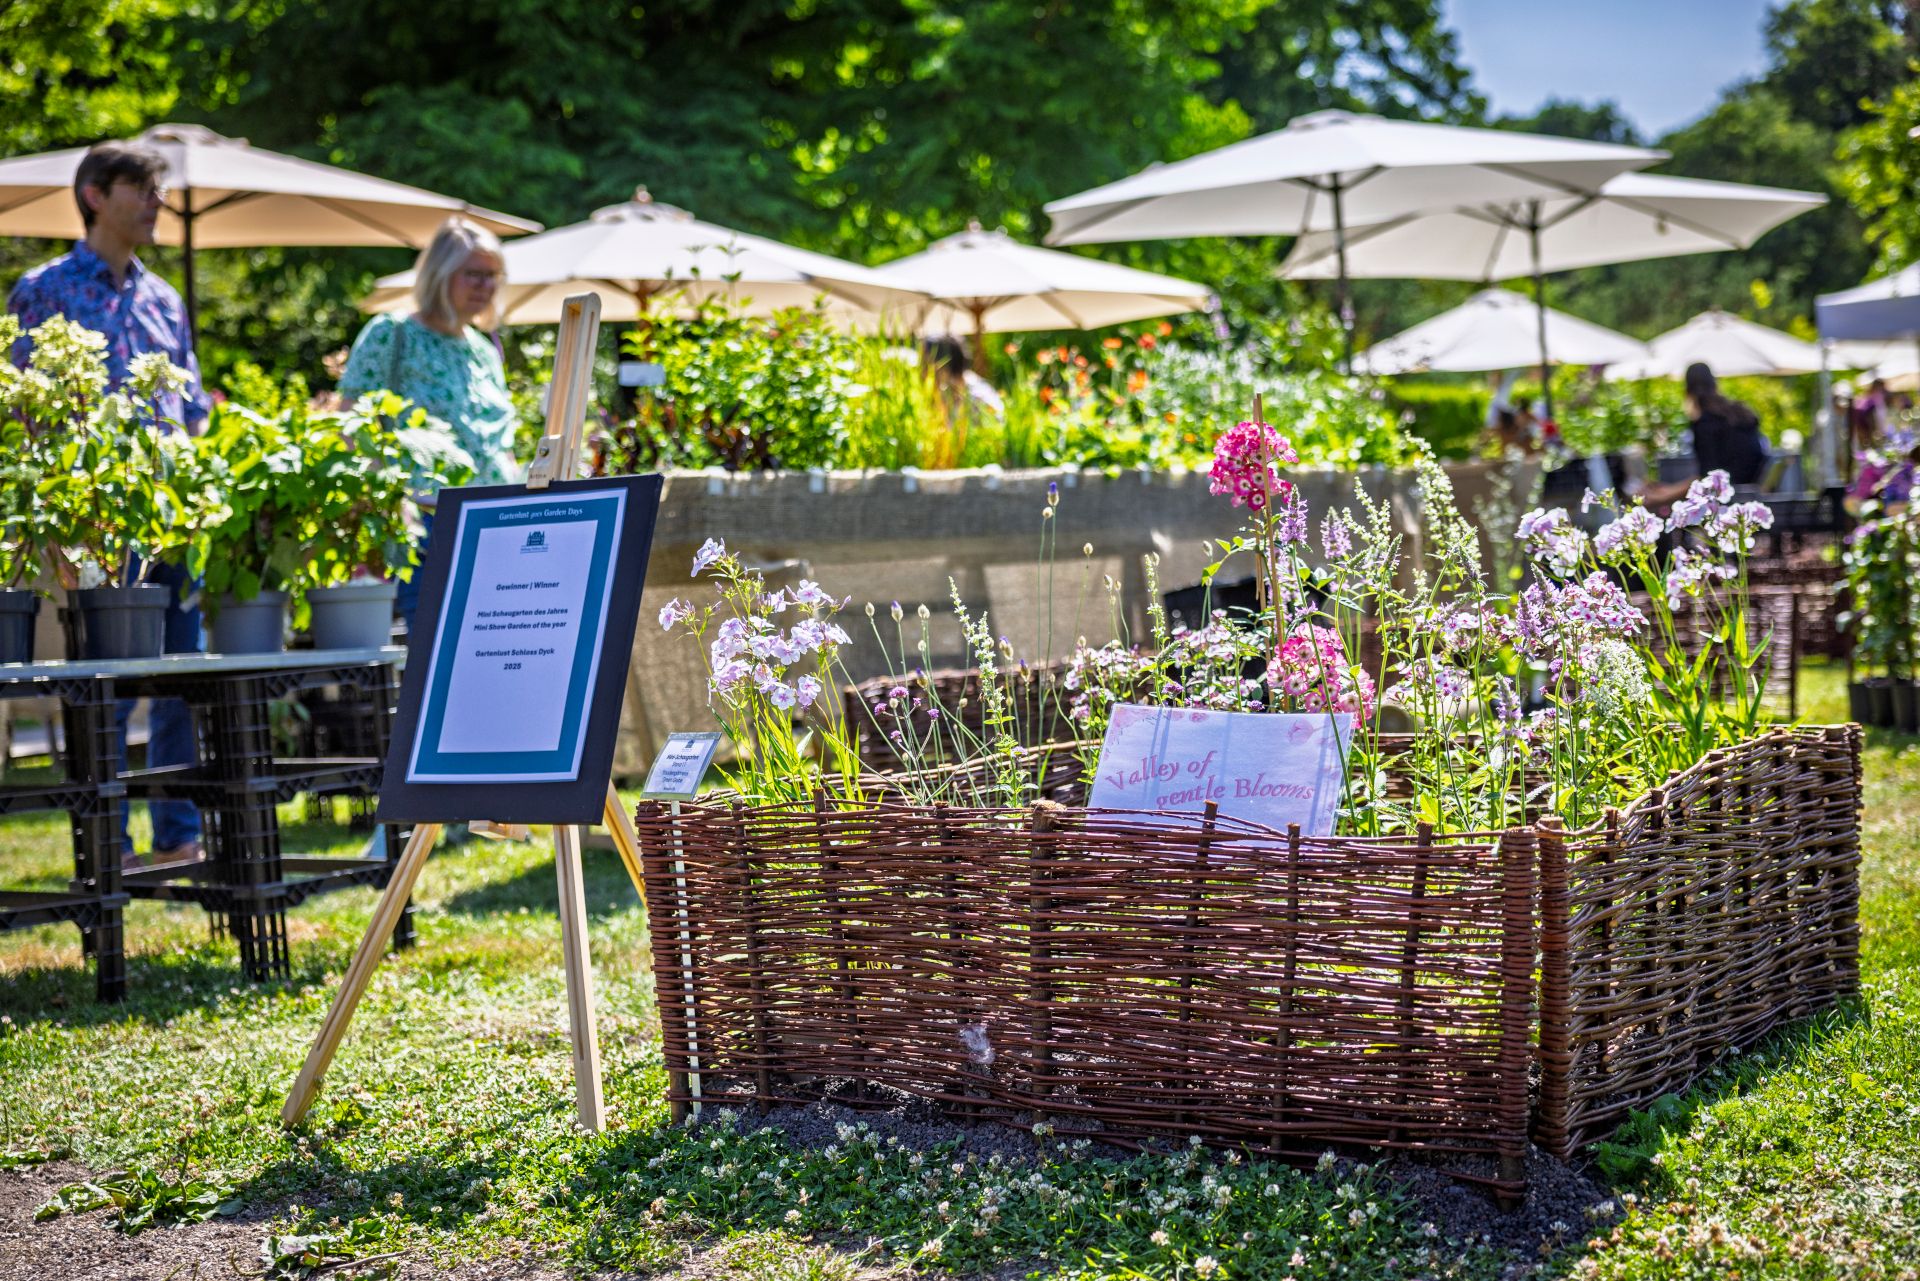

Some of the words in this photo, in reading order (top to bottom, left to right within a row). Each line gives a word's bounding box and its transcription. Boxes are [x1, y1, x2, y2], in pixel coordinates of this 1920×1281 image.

[499, 511, 529, 520] Gartenlust
[544, 508, 566, 517] Garden
[568, 507, 583, 517] Days
[496, 583, 528, 591] Gewinner
[534, 581, 560, 589] Winner
[492, 609, 533, 618] Schaugarten
[488, 623, 506, 631] Show
[507, 622, 531, 630] Garden
[552, 621, 567, 629] year
[475, 649, 510, 657] Gartenlust
[511, 648, 537, 656] Schloss
[538, 647, 555, 657] Dyck
[503, 662, 522, 670] 2025
[1105, 754, 1180, 790] Valley
[1187, 750, 1218, 778] of
[1156, 774, 1226, 810] gentle
[1234, 772, 1317, 800] Blooms
